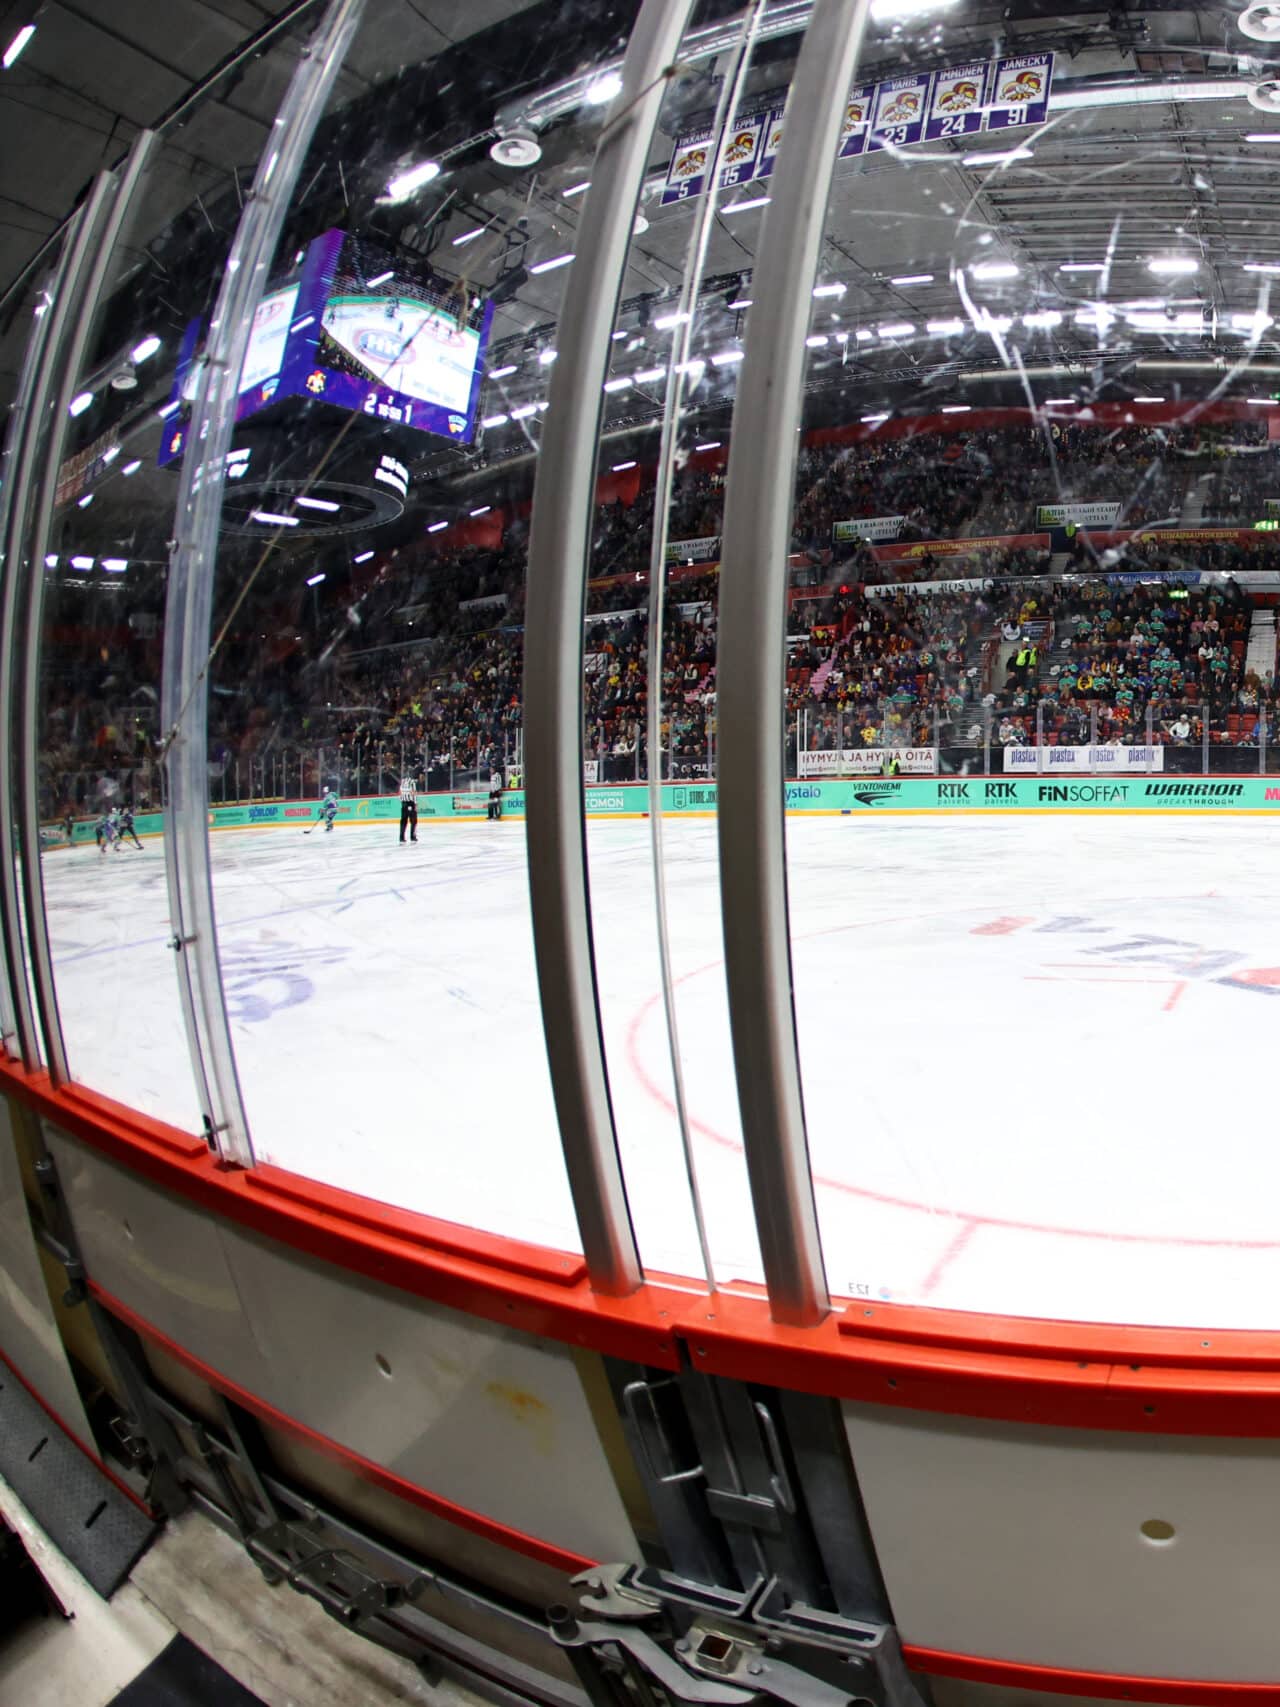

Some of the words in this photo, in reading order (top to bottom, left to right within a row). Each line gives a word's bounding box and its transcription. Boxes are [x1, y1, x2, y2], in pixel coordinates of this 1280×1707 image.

[1002, 56, 1048, 71] JANECKY
[940, 66, 984, 81] IMMONEN
[1007, 107, 1027, 125] 91
[940, 116, 966, 136] 24
[885, 126, 907, 145] 23
[723, 166, 740, 186] 15
[678, 180, 690, 199] 5
[363, 392, 378, 414] 2
[405, 404, 413, 425] 1
[1011, 748, 1036, 765] plastex
[1049, 748, 1075, 765] plastex
[853, 782, 902, 792] VENTONIEMI
[938, 783, 969, 798] RTK
[985, 783, 1017, 798] RTK
[1144, 783, 1244, 796] WARRIOR
